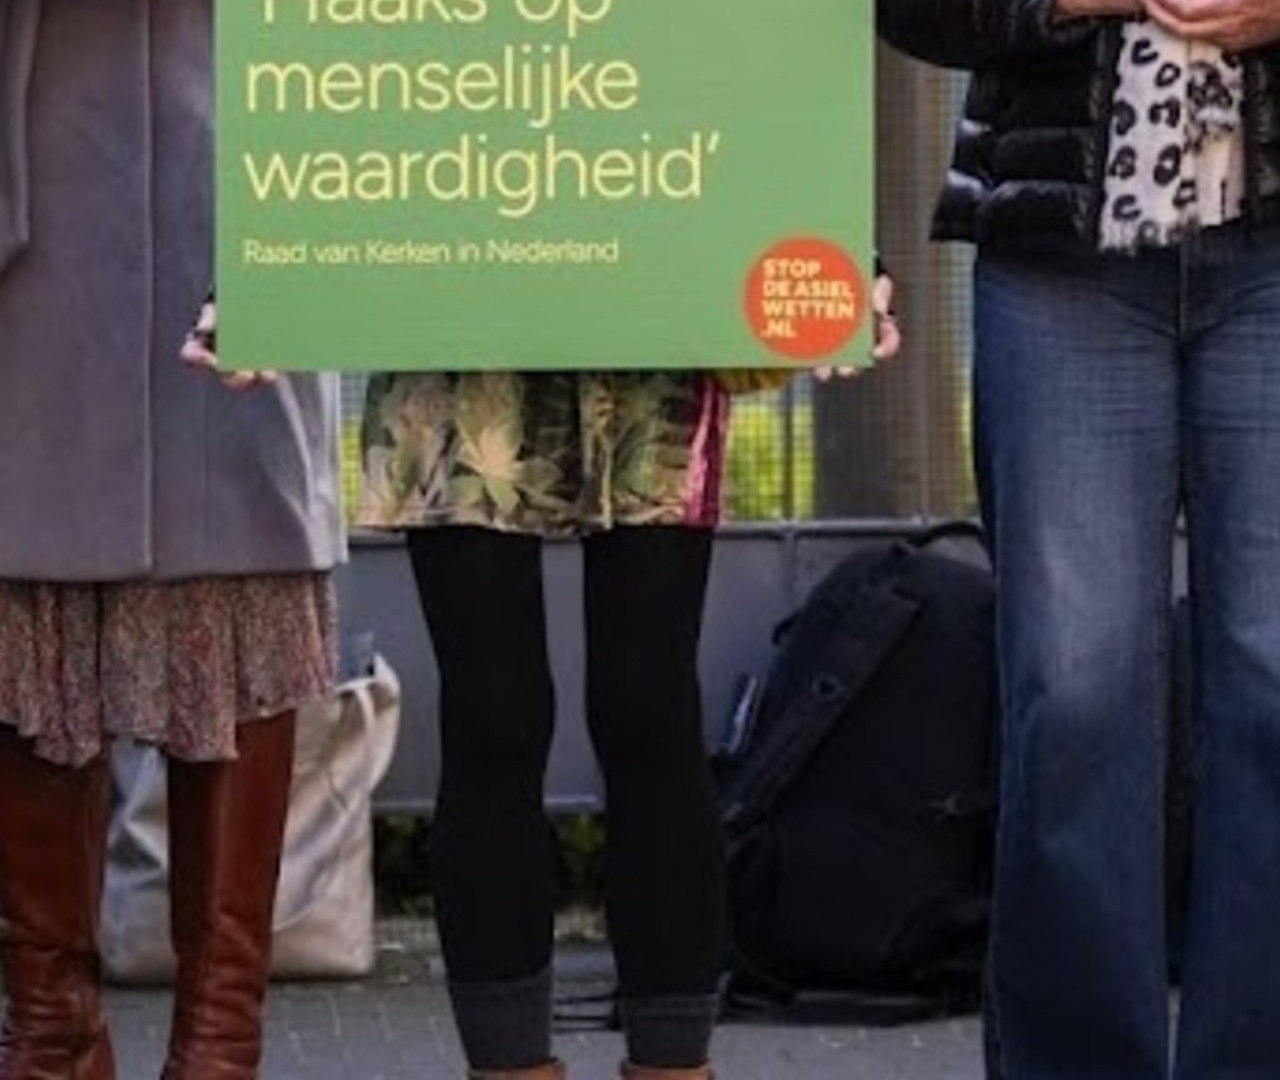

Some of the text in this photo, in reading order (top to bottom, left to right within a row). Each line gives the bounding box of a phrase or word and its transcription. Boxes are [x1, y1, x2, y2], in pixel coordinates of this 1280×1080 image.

[247, 45, 639, 126] menselijke
[243, 131, 720, 214] waardigheid'
[244, 239, 619, 264] Raad van Kerken in Nederland
[763, 258, 822, 278] STOP
[763, 280, 855, 298] DE ASIEL
[762, 300, 855, 320] WETTEN
[760, 320, 799, 338] .NL
